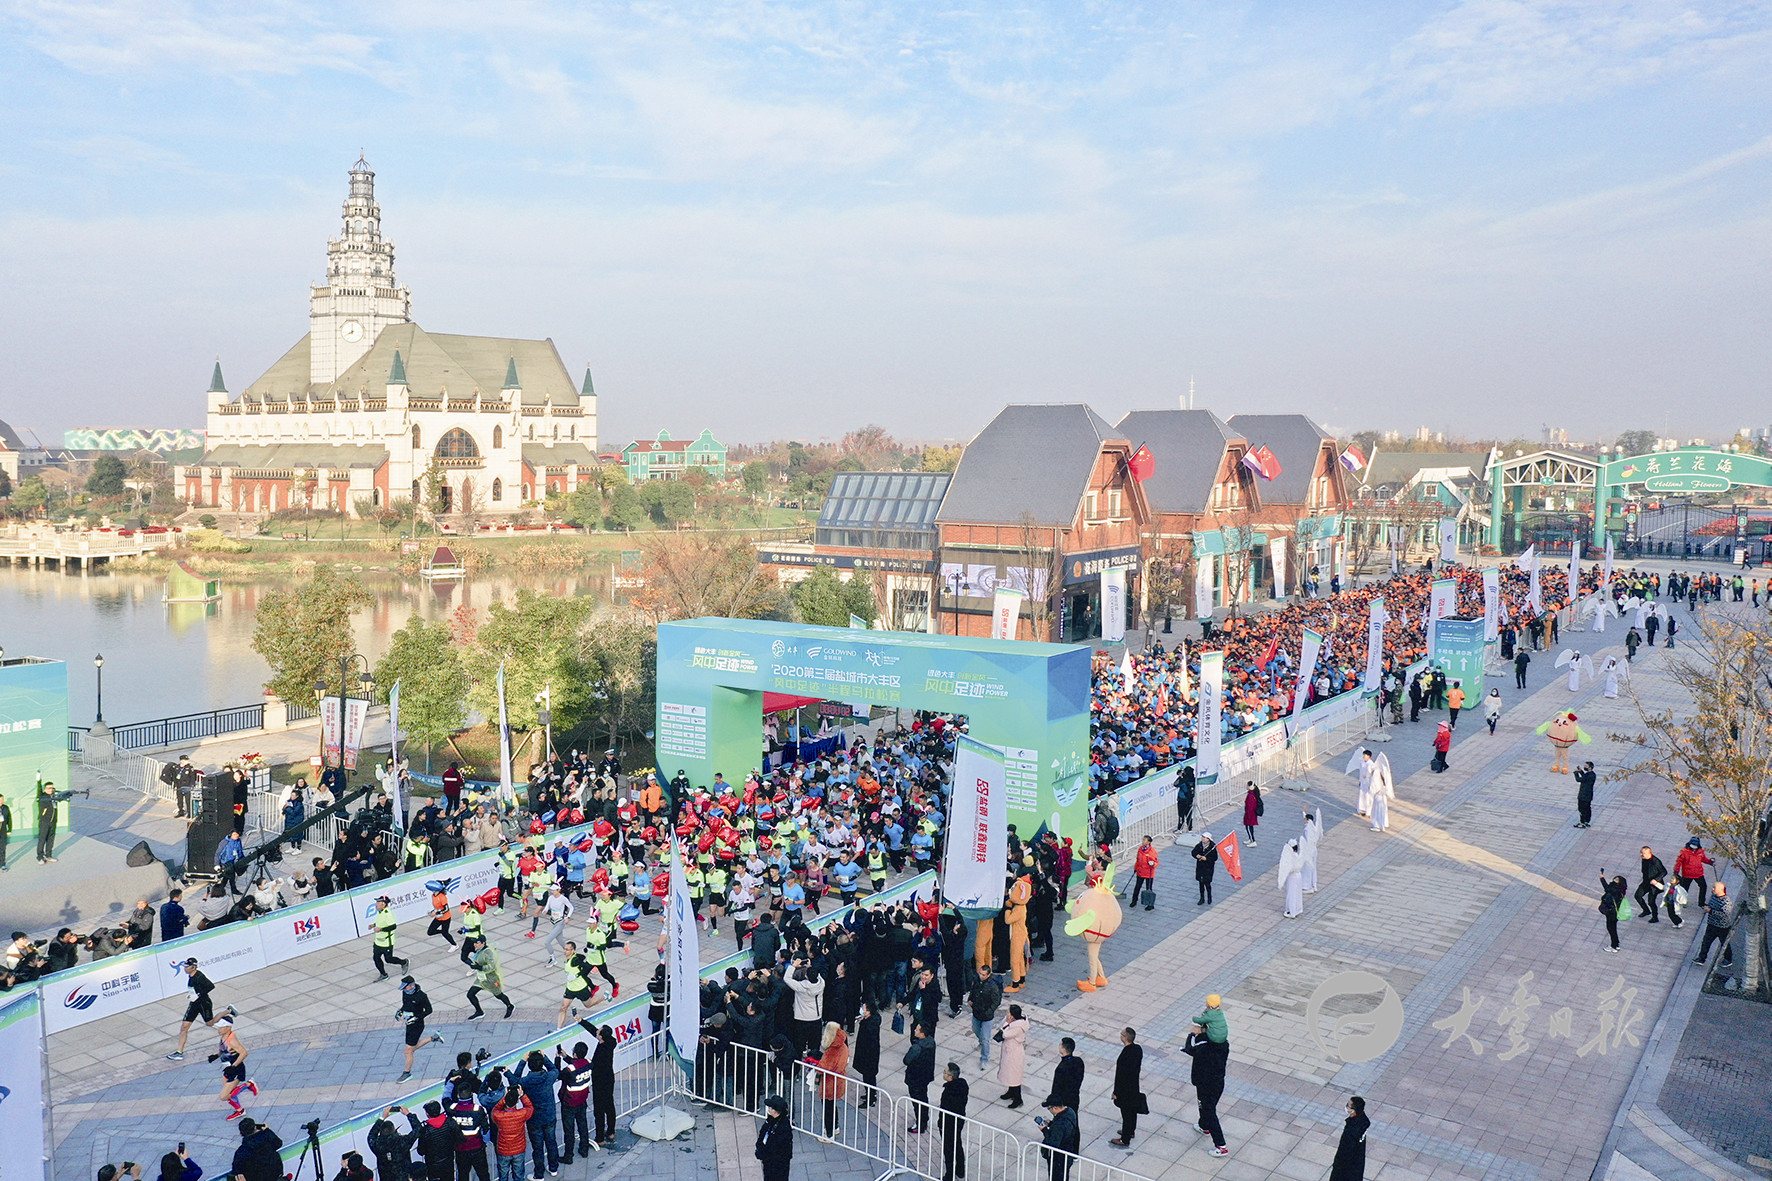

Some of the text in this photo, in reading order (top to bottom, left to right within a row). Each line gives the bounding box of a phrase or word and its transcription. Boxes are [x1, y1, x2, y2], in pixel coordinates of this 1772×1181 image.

[1646, 455, 1732, 474] 荷兰花海
[1111, 556, 1129, 566] POLICE
[824, 648, 856, 657] GOLDWIND
[692, 654, 740, 672] 风中足迹
[924, 678, 985, 698] 风中足迹
[1267, 732, 1283, 746] FESCO
[390, 889, 427, 906] 风体育文化
[101, 972, 140, 991] 中科宇能
[102, 982, 141, 999] Sino-wind
